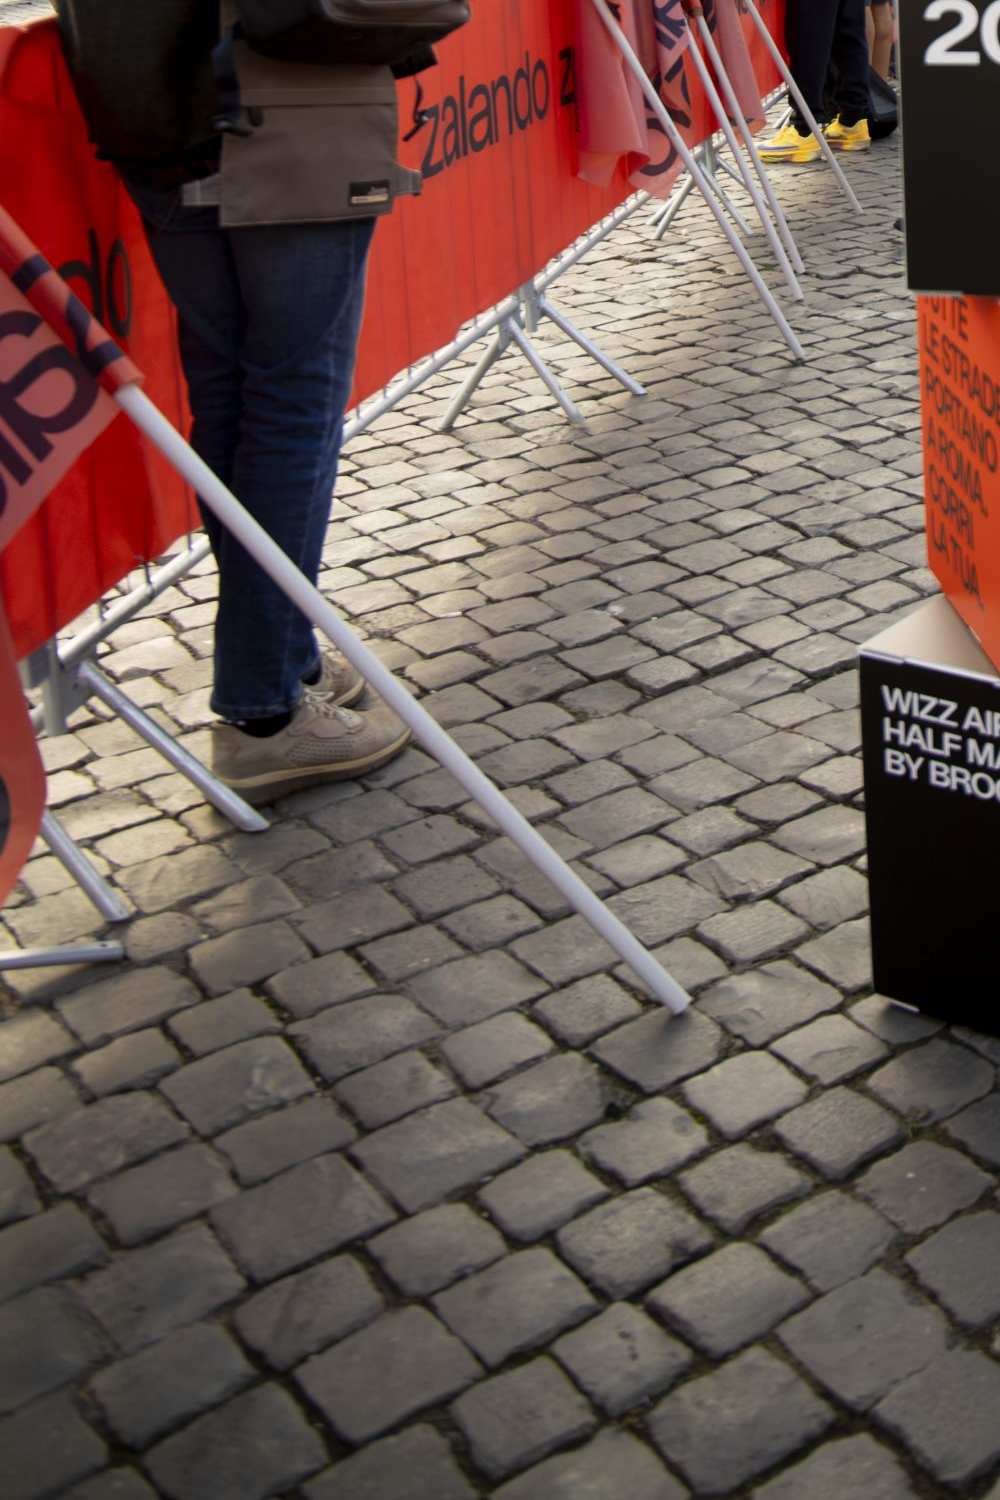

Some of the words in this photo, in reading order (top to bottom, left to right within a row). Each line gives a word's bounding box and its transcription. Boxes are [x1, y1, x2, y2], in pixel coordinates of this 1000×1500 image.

[421, 51, 549, 180] zalando
[923, 314, 939, 363] LE
[925, 364, 998, 474] PORTANO
[938, 426, 988, 517] ROMA.
[929, 464, 974, 549] CORRI
[931, 508, 949, 565] LA
[881, 684, 958, 728] WIZZ
[883, 717, 962, 757] HALF
[884, 748, 924, 780] BY
